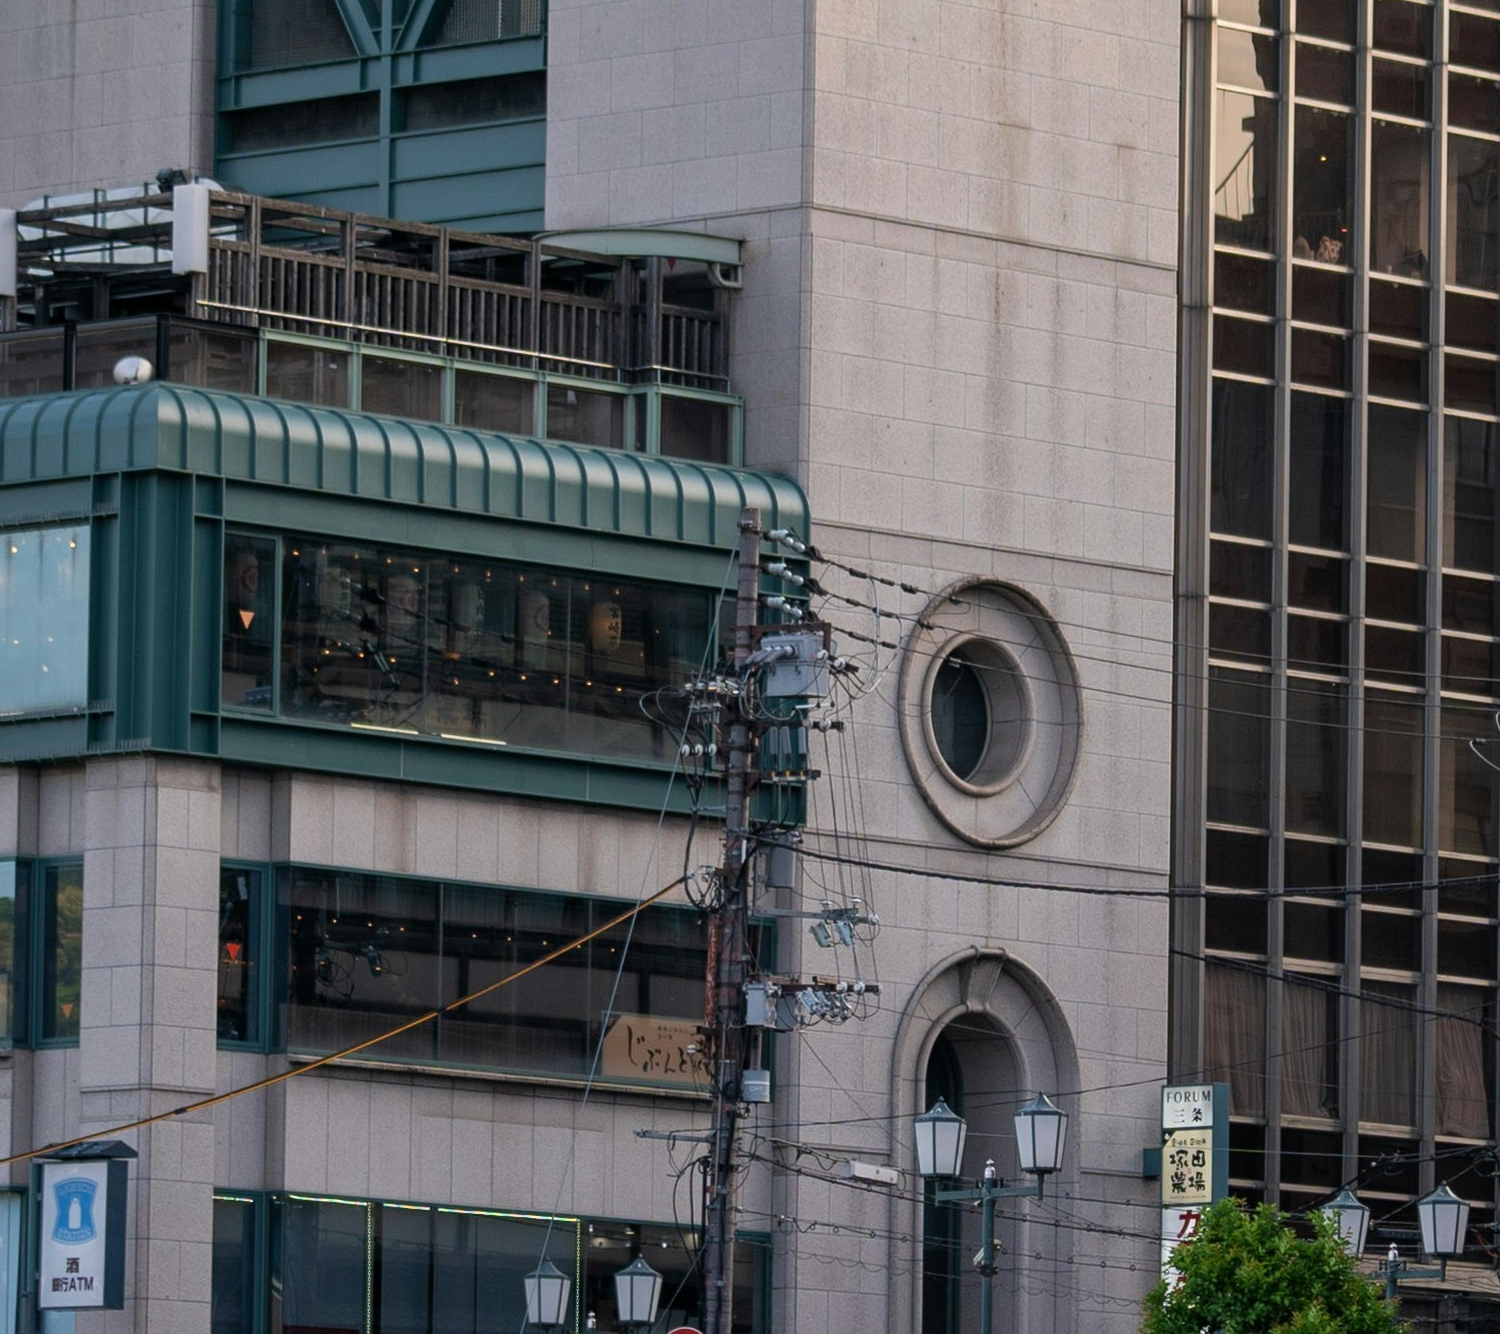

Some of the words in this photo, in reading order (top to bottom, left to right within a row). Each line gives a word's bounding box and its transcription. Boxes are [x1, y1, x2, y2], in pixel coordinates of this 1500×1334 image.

[1166, 1090, 1211, 1103] FORUM
[1173, 1107, 1202, 1123] 三条
[66, 1257, 80, 1274] 酒
